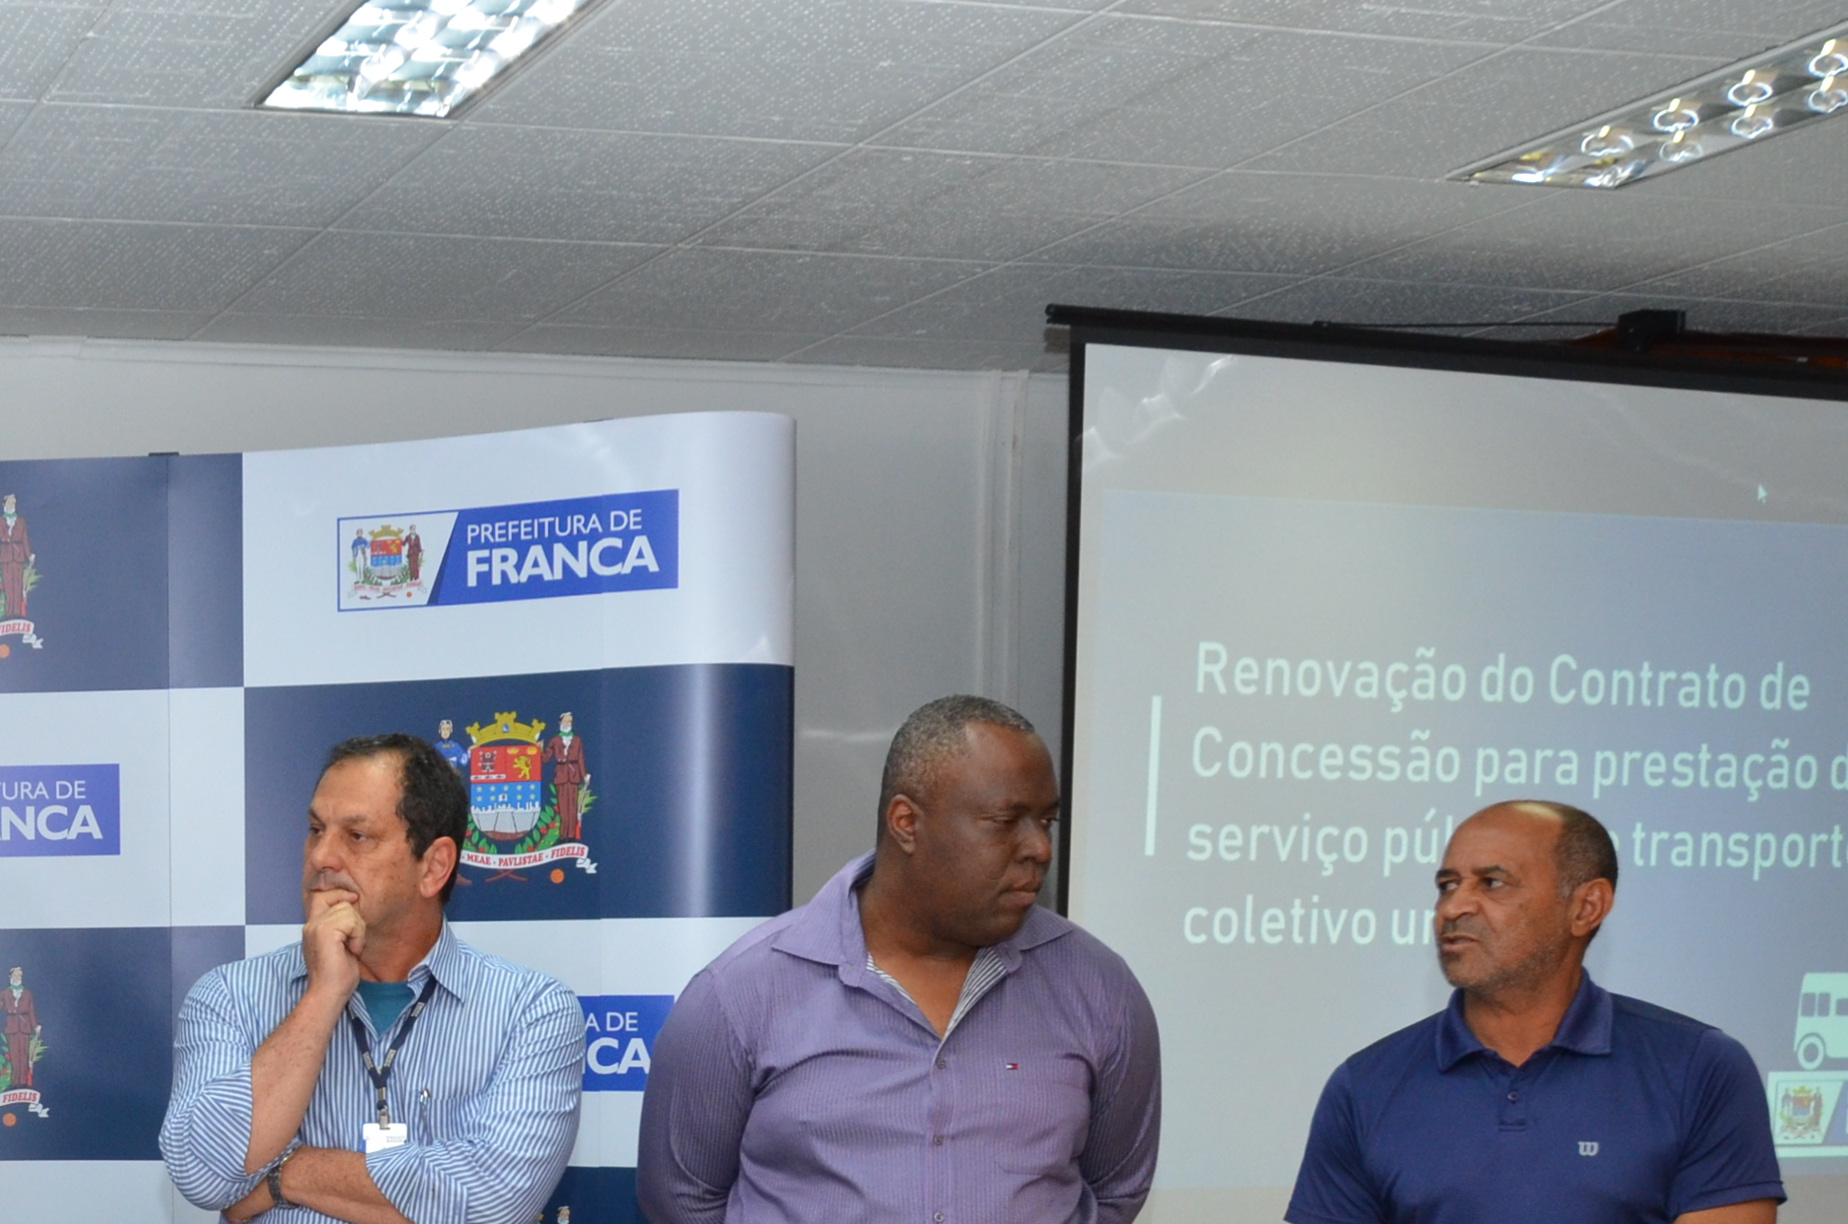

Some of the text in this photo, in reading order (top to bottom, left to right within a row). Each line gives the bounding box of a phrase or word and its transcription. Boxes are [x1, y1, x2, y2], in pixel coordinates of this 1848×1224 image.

[467, 509, 642, 544] PREFEITURA DE
[466, 536, 659, 587] FRANCA
[1196, 641, 1811, 713] Renovação do Contrato de
[1192, 727, 1460, 785] Concessão
[1475, 752, 1579, 797] para
[1592, 737, 1818, 802] prestação
[56, 780, 86, 800] DE
[551, 845, 586, 859] FIDELIS
[1186, 812, 1369, 877] serviço
[1632, 821, 1848, 883] transport
[1183, 894, 1376, 945] coletivo
[606, 1011, 639, 1032] DE
[2, 1091, 38, 1104] FIDELIS
